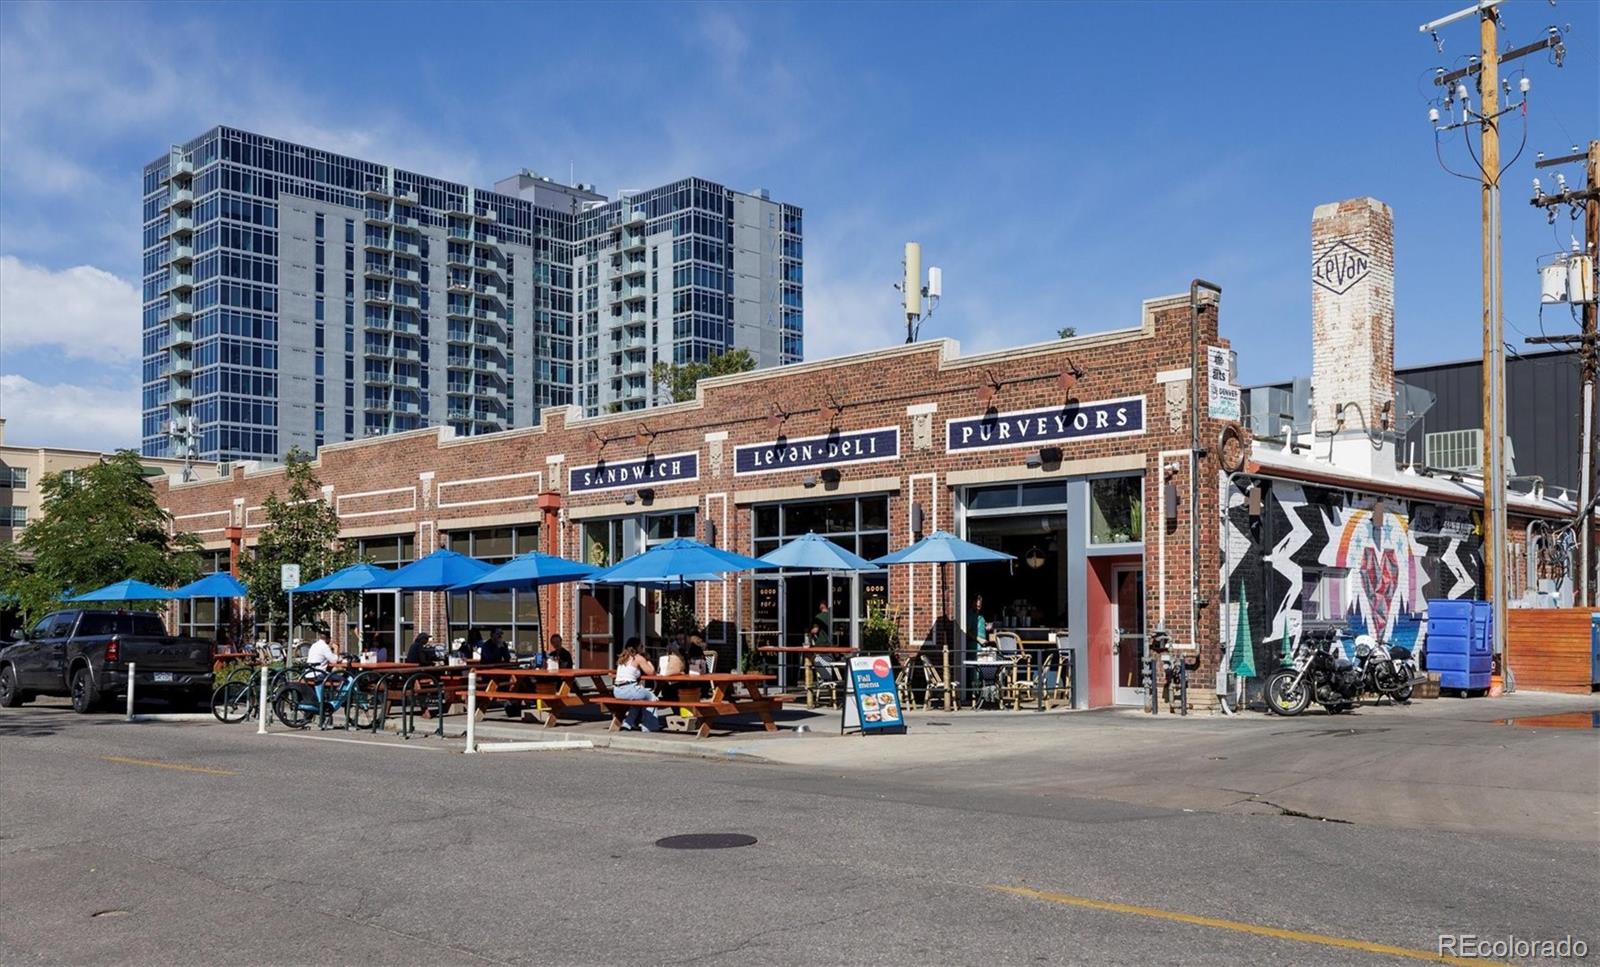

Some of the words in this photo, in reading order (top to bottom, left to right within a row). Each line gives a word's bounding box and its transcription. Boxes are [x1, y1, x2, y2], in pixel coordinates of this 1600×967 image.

[962, 407, 1128, 444] PURVEYORS
[584, 460, 681, 486] SANDWICH
[857, 673, 871, 682] Fall
[858, 681, 880, 689] menu
